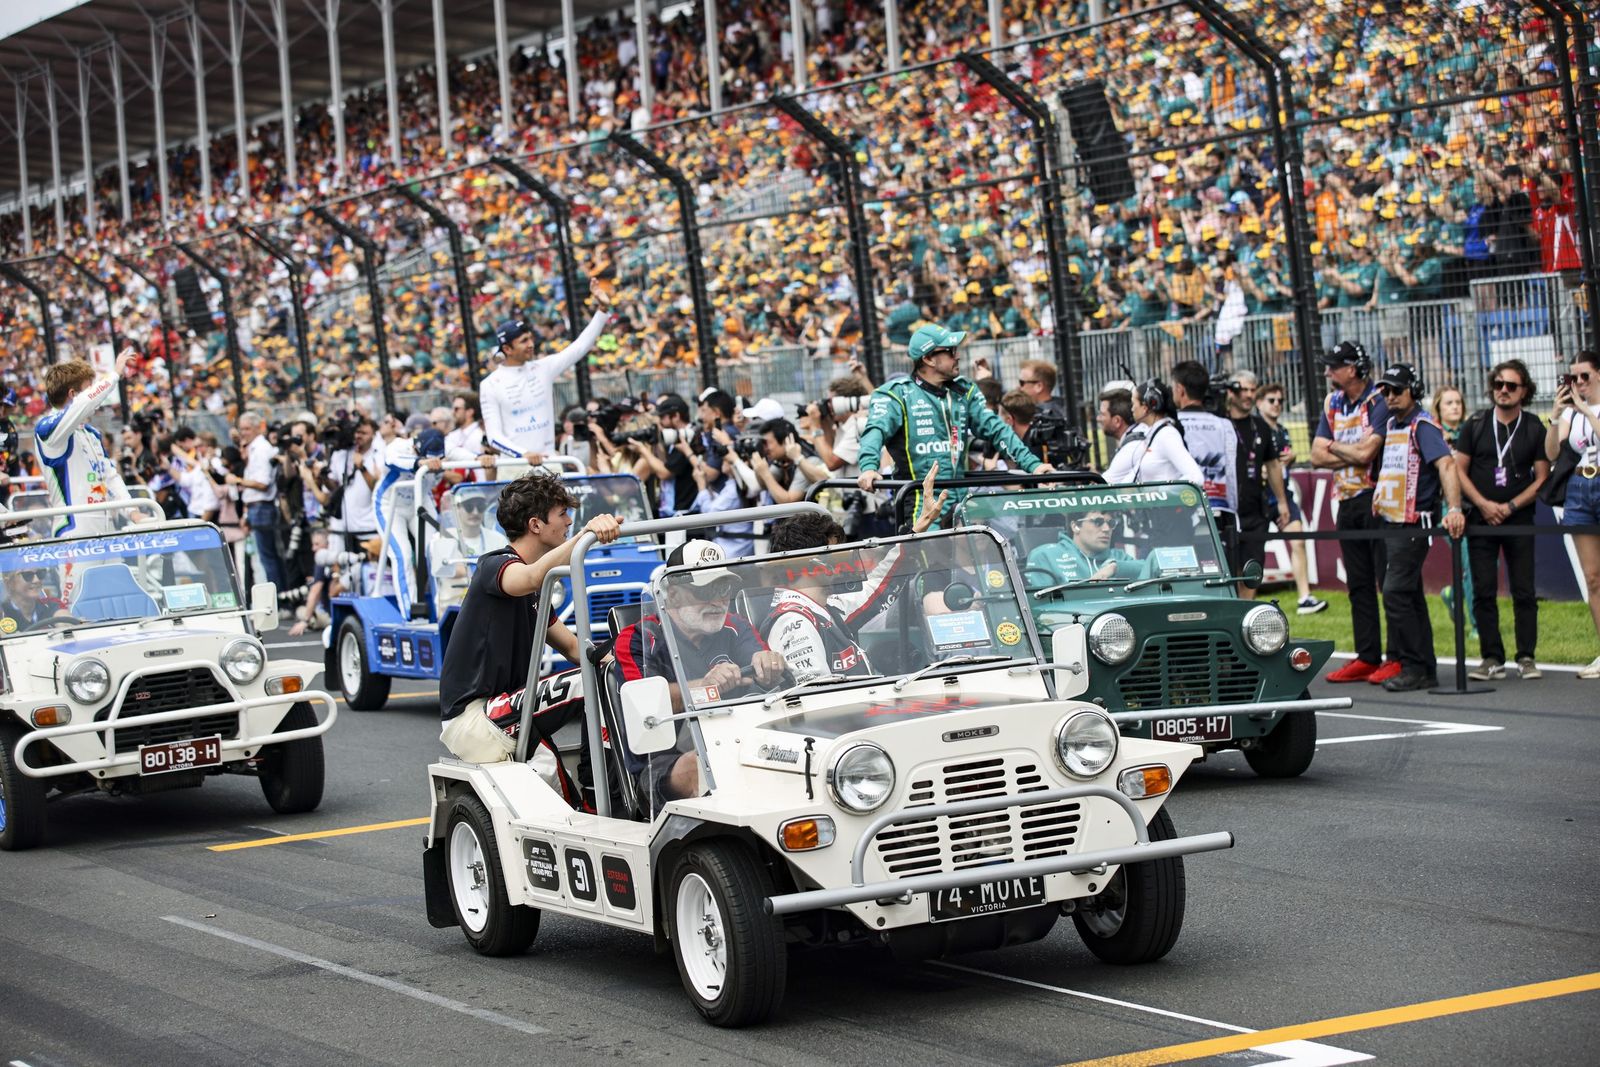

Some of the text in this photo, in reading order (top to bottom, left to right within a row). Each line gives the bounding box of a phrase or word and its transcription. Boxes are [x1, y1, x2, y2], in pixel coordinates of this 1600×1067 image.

[1003, 491, 1168, 511] ASTON MARTIN
[24, 538, 178, 563] RACING BULLS
[795, 658, 813, 669] FIX
[708, 687, 717, 699] 6
[957, 729, 985, 738] MOKE
[169, 762, 194, 770] VICTORIA
[530, 859, 553, 871] AUSTRALIAN
[532, 867, 545, 876] GRAND
[571, 857, 590, 893] 31
[607, 869, 628, 882] ESTEBAN
[971, 902, 1006, 913] VICTORIA
